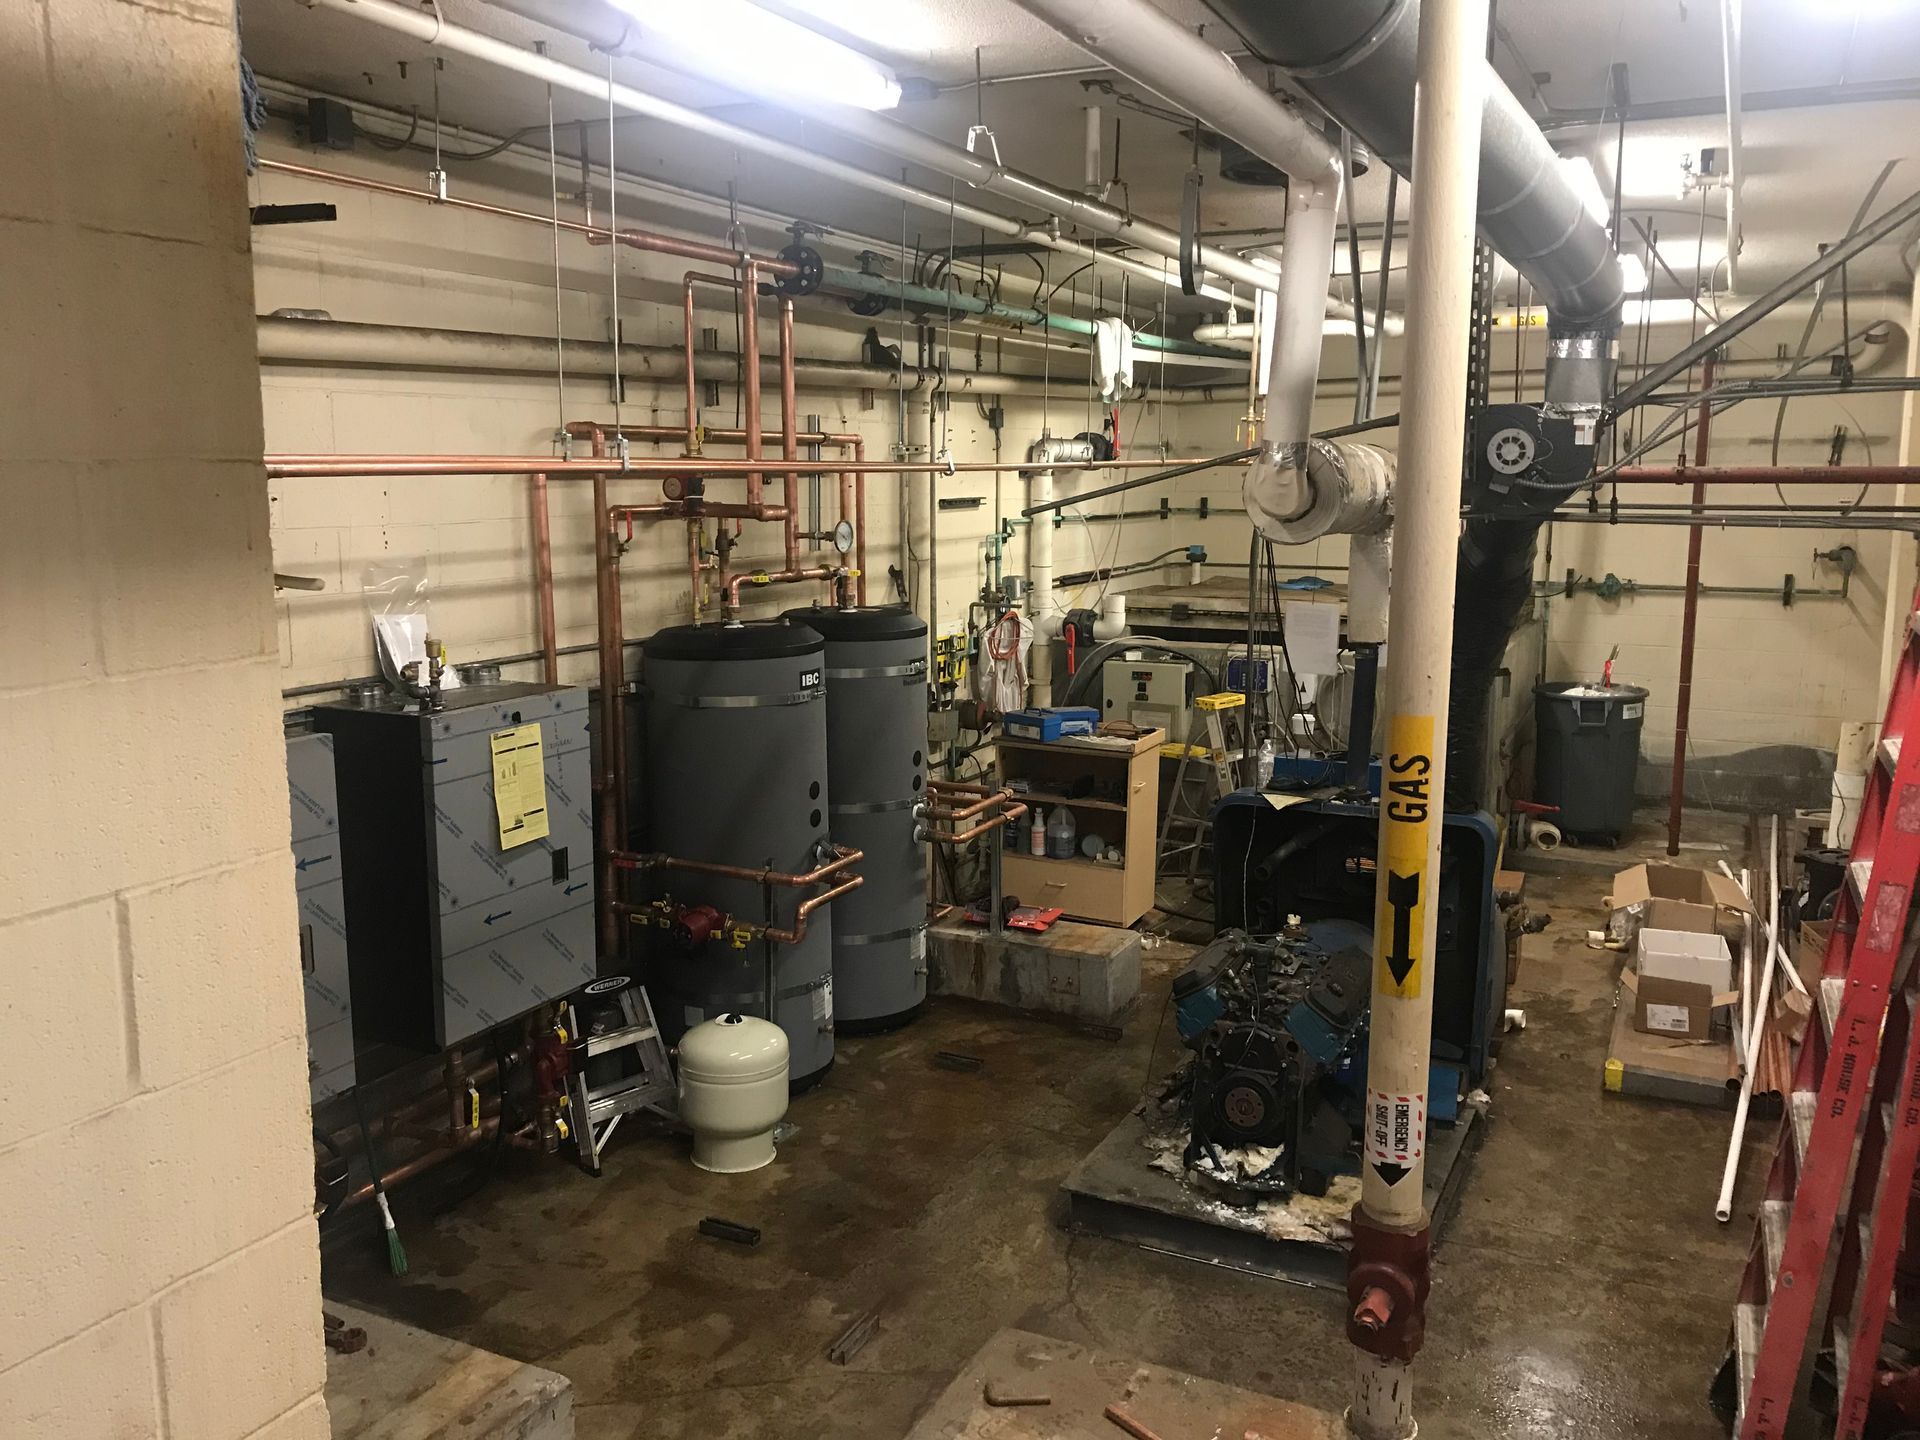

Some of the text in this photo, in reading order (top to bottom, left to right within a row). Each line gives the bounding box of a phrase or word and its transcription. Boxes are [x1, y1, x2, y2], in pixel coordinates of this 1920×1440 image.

[1519, 316, 1536, 326] GAS
[801, 672, 820, 687] IBC
[1388, 753, 1431, 823] GAS
[594, 978, 622, 991] WERNER
[1375, 1104, 1388, 1148] SHUT-OFF
[1394, 1104, 1409, 1153] EMERGENCY
